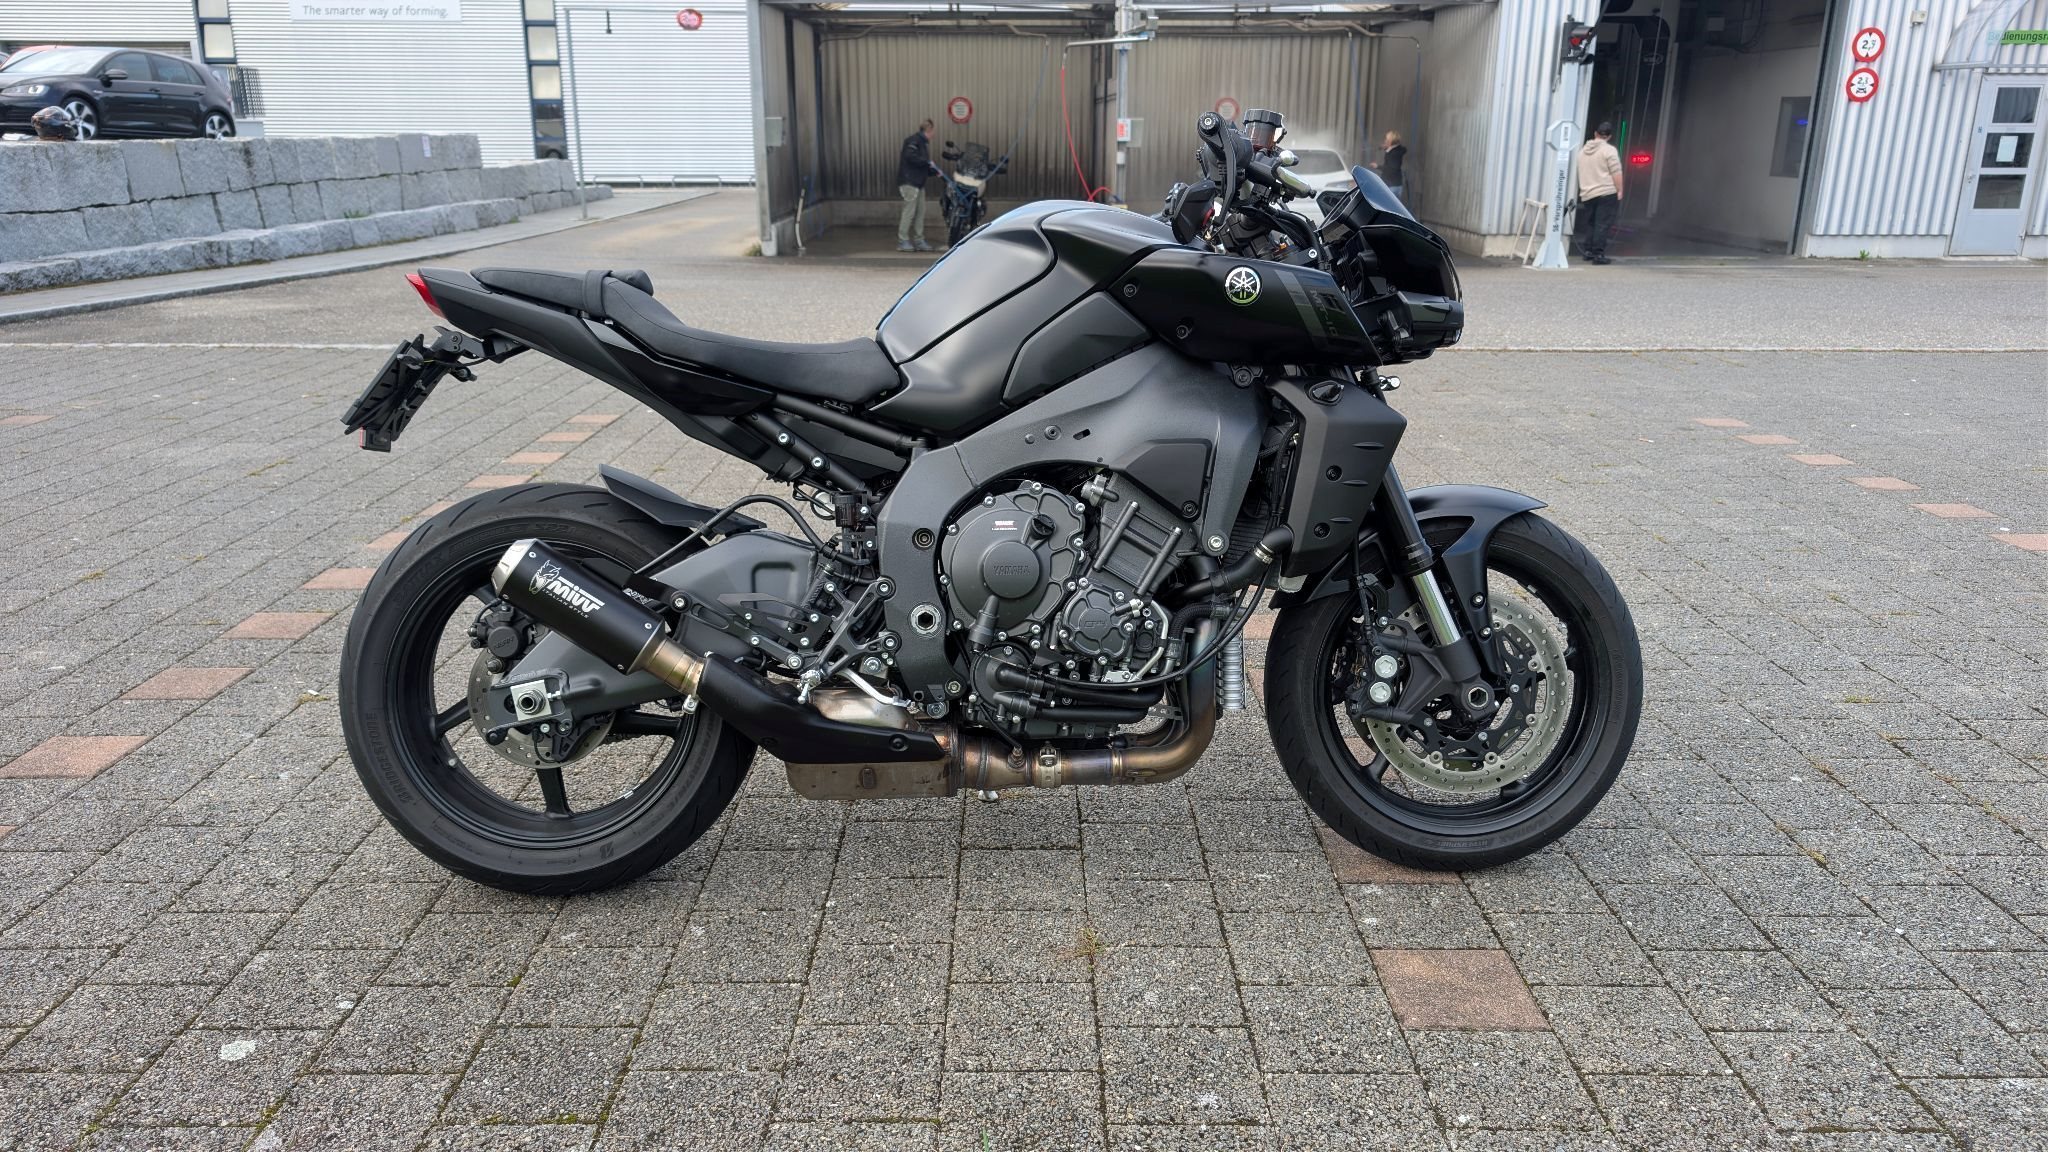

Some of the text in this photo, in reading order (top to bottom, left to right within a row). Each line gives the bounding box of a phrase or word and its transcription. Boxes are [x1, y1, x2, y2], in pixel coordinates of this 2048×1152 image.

[303, 5, 449, 18] The smarter way of forming.
[542, 588, 590, 619] ITALIAN STYLE
